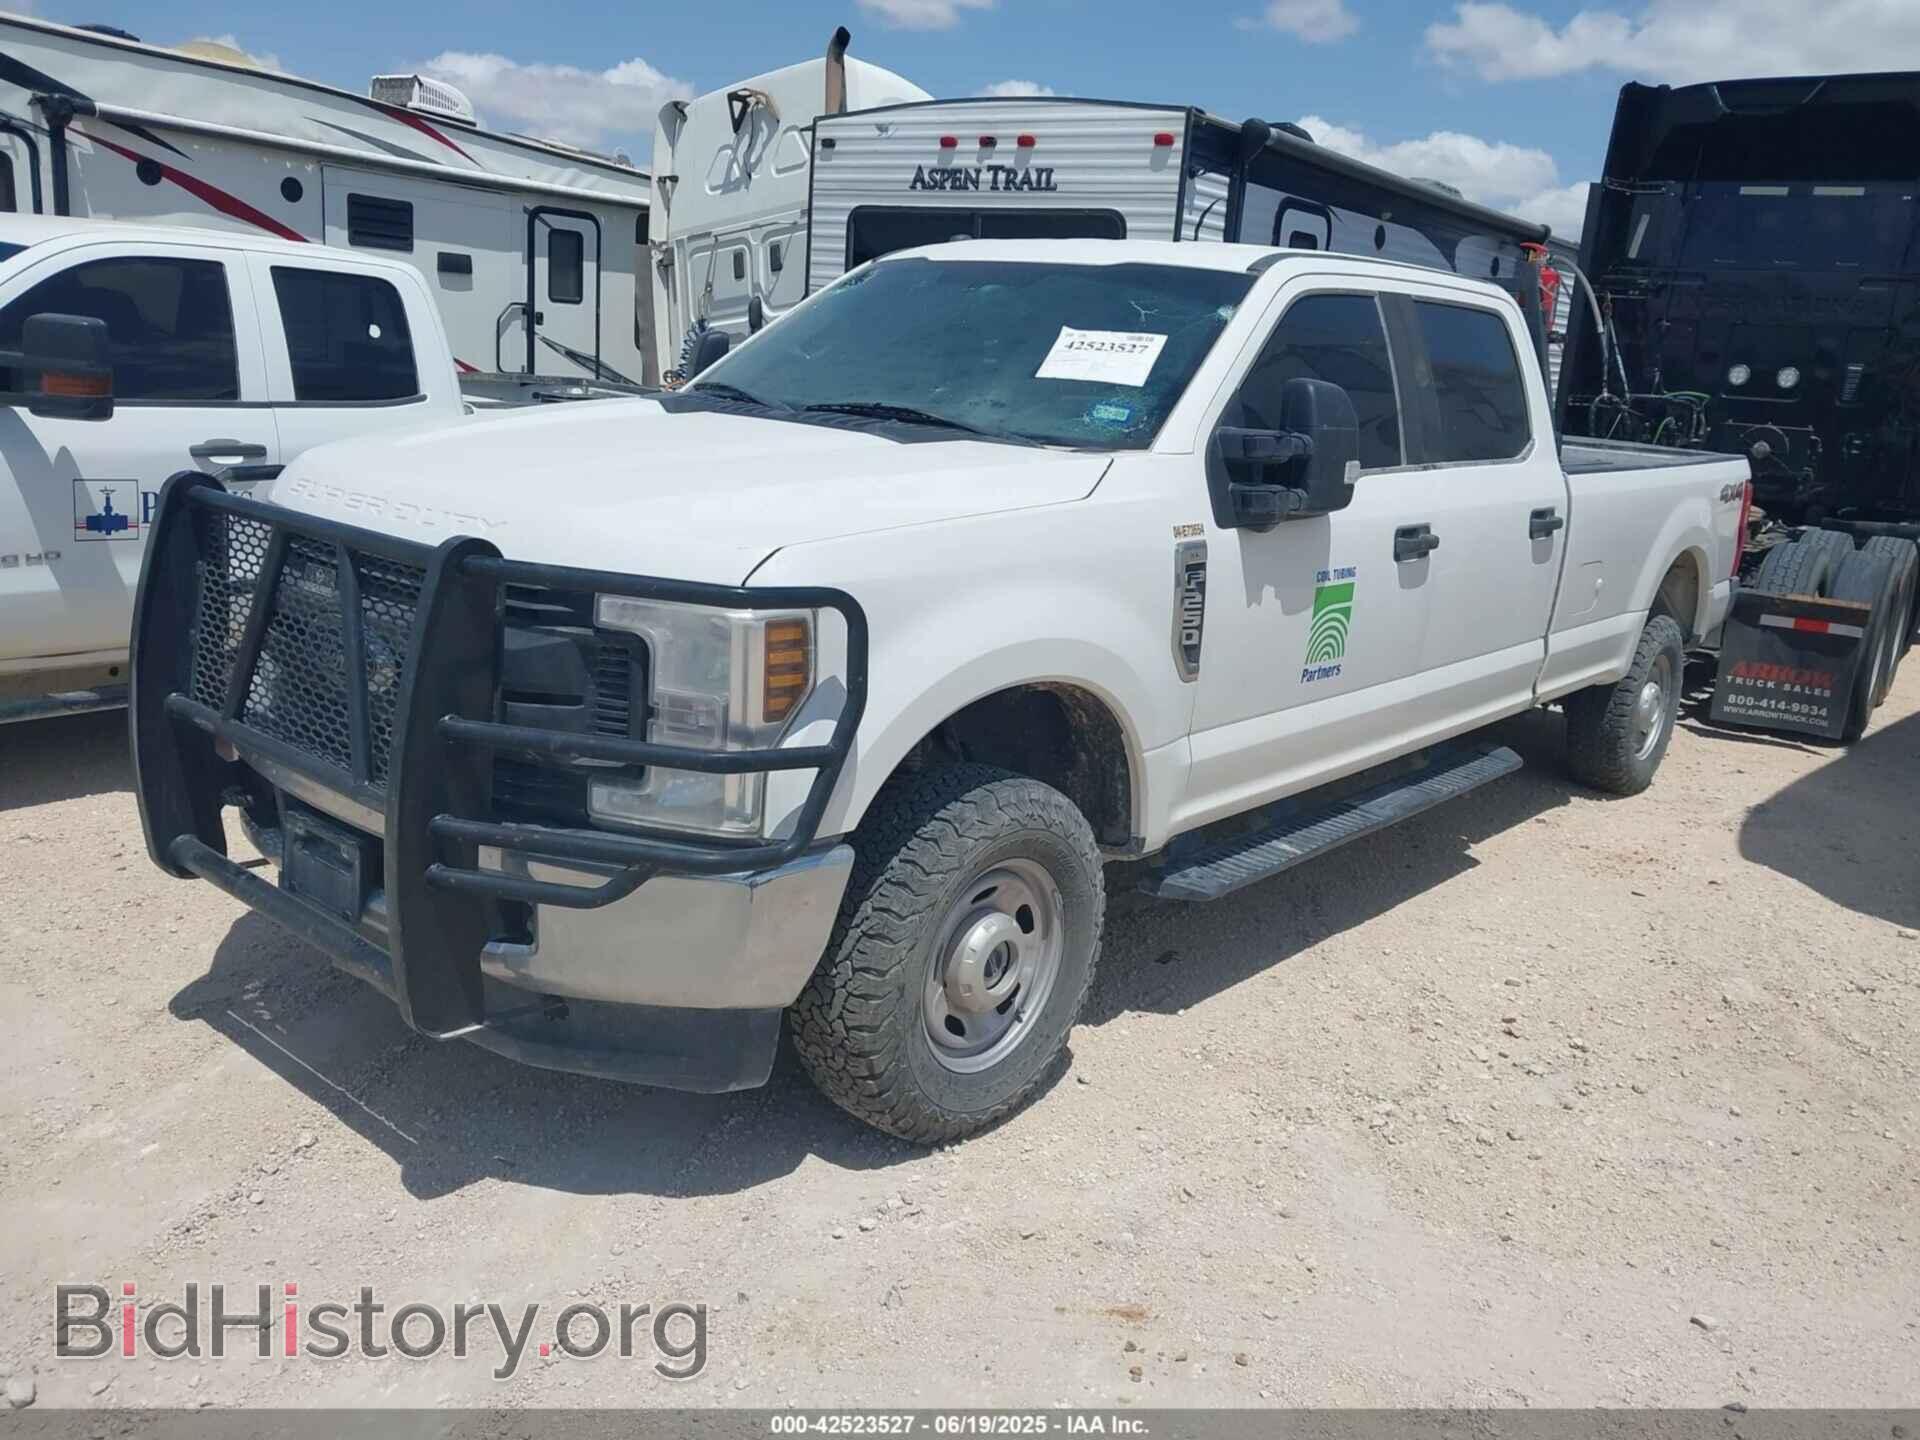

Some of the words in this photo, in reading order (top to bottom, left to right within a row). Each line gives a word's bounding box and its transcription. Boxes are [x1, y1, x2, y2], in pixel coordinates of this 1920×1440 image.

[909, 164, 982, 191] ASPEN
[987, 165, 1058, 191] TRAIL
[1064, 341, 1149, 354] 42523527
[289, 478, 389, 517] SUPER
[394, 501, 509, 532] DUTY
[1301, 664, 1342, 684] Partners
[1727, 660, 1835, 688] ARROW
[1726, 675, 1777, 689] TRUCK
[1783, 683, 1832, 697] SALES
[1723, 705, 1829, 728] WWW.ARROWTRUCK.COM
[1727, 694, 1828, 717] 800-414-9934
